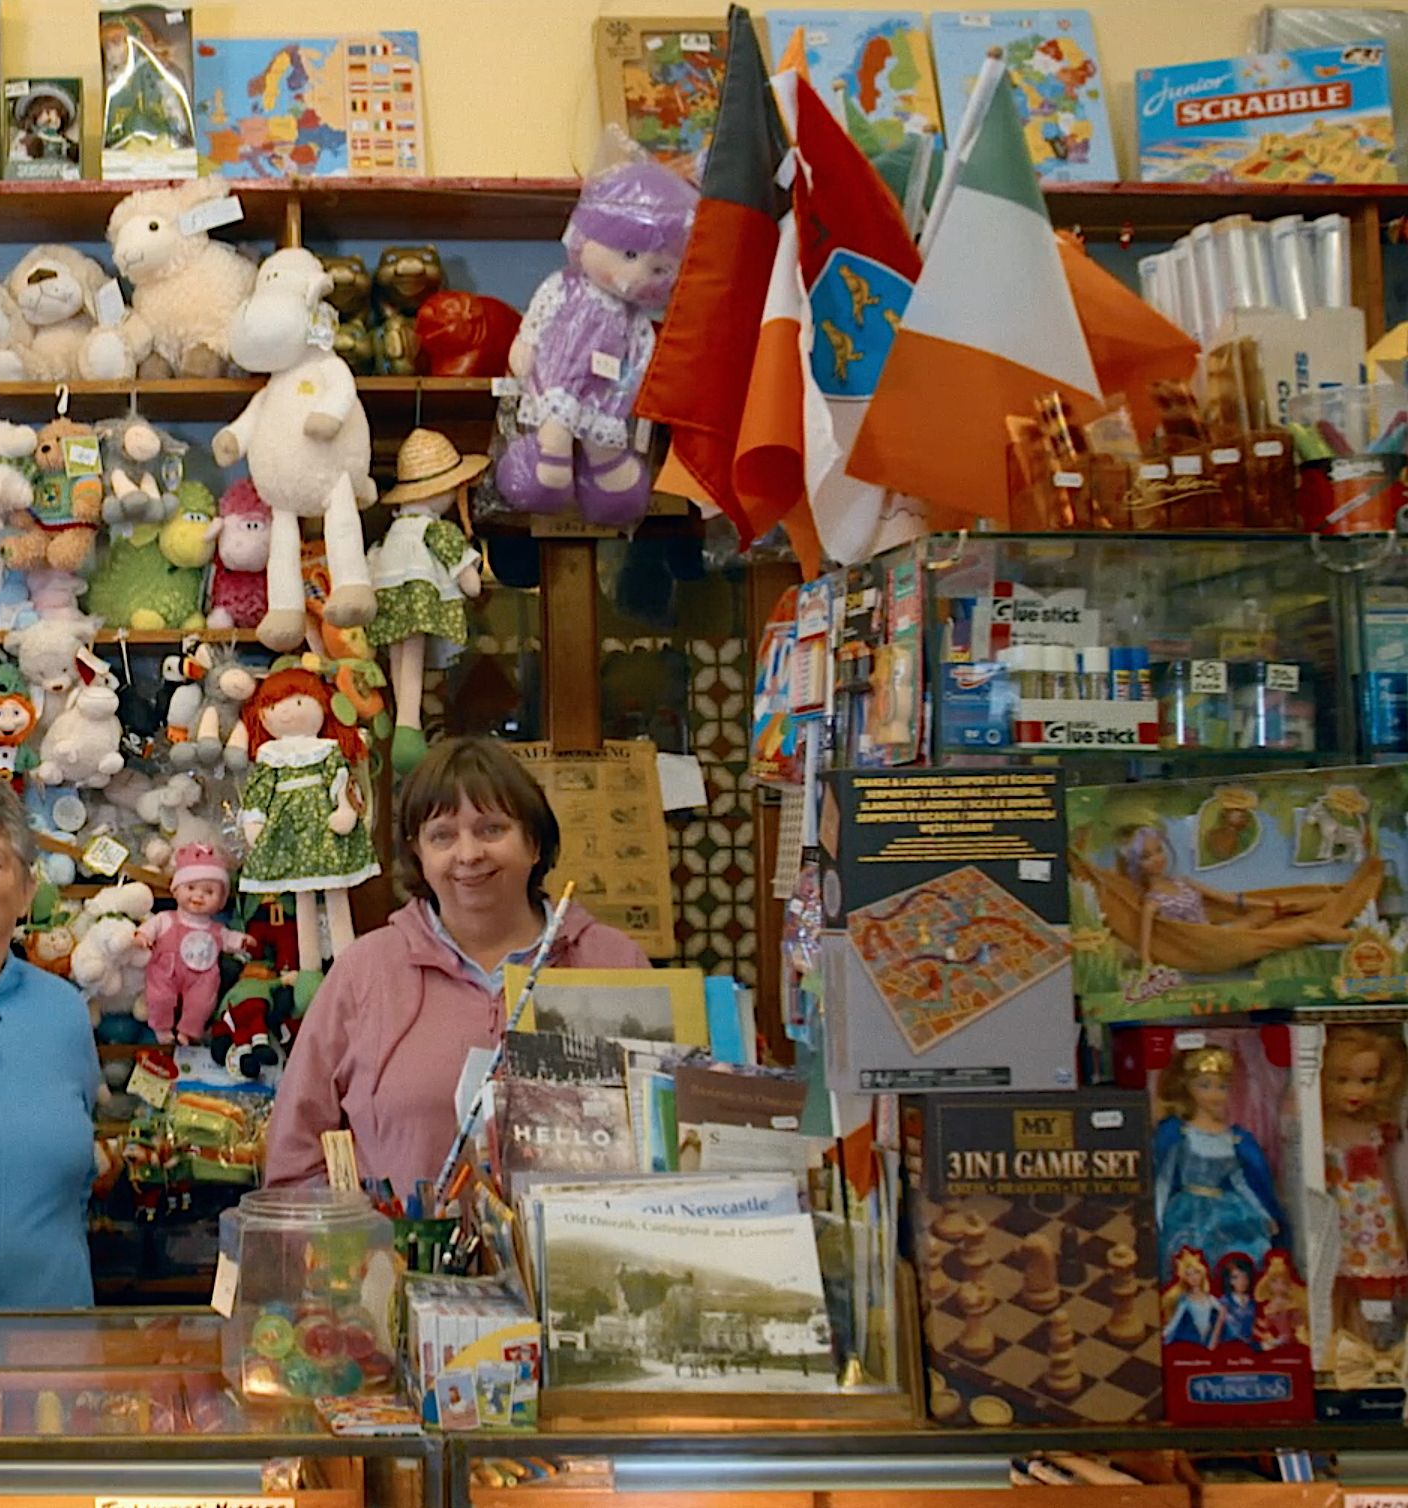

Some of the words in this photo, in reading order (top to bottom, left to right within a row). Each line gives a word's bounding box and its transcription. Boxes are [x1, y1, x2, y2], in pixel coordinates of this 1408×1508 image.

[1143, 71, 1232, 116] Junior
[1181, 84, 1346, 124] SCRABBLE
[1042, 605, 1080, 624] stick
[1098, 723, 1136, 744] stick
[513, 1124, 612, 1147] HELLO
[1013, 1150, 1090, 1180] GAME
[1091, 1150, 1141, 1179] SET
[680, 1195, 770, 1218] Newcastle
